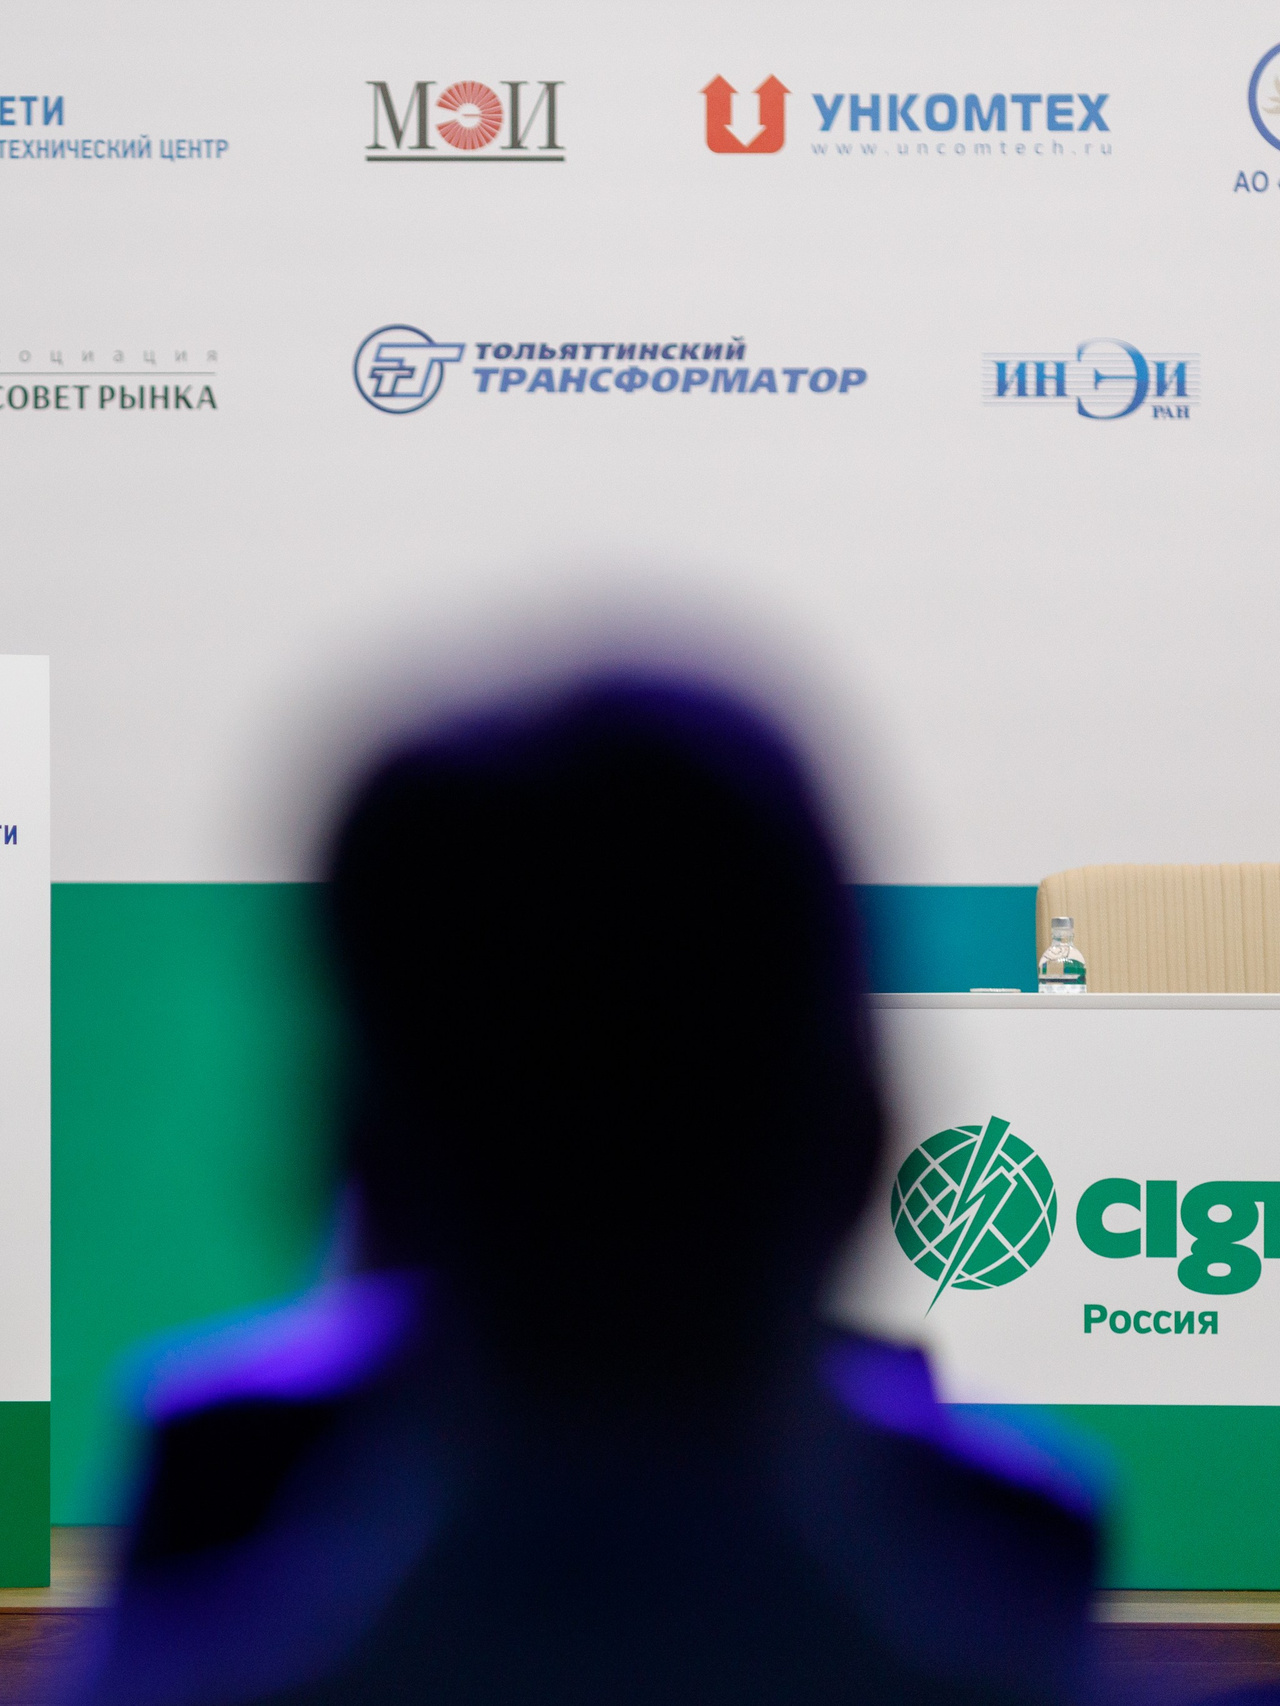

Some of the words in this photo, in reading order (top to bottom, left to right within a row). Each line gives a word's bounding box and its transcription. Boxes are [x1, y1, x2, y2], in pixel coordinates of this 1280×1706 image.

[811, 93, 1111, 132] УНКОМТЕХ
[160, 138, 230, 162] ЦЕНТР
[811, 139, 1114, 156] www.uncomtech.ru
[1233, 170, 1270, 193] АО
[475, 336, 747, 360] ТОЛЬЯТТИНСКИЙ
[472, 365, 870, 394] ТРАНСФОРМАТОР
[993, 337, 1190, 420] ИНЭИ
[99, 385, 218, 410] РЫНКА
[1152, 404, 1191, 419] РАН
[1076, 1177, 1280, 1296] cig
[1084, 1303, 1220, 1335] Россия
